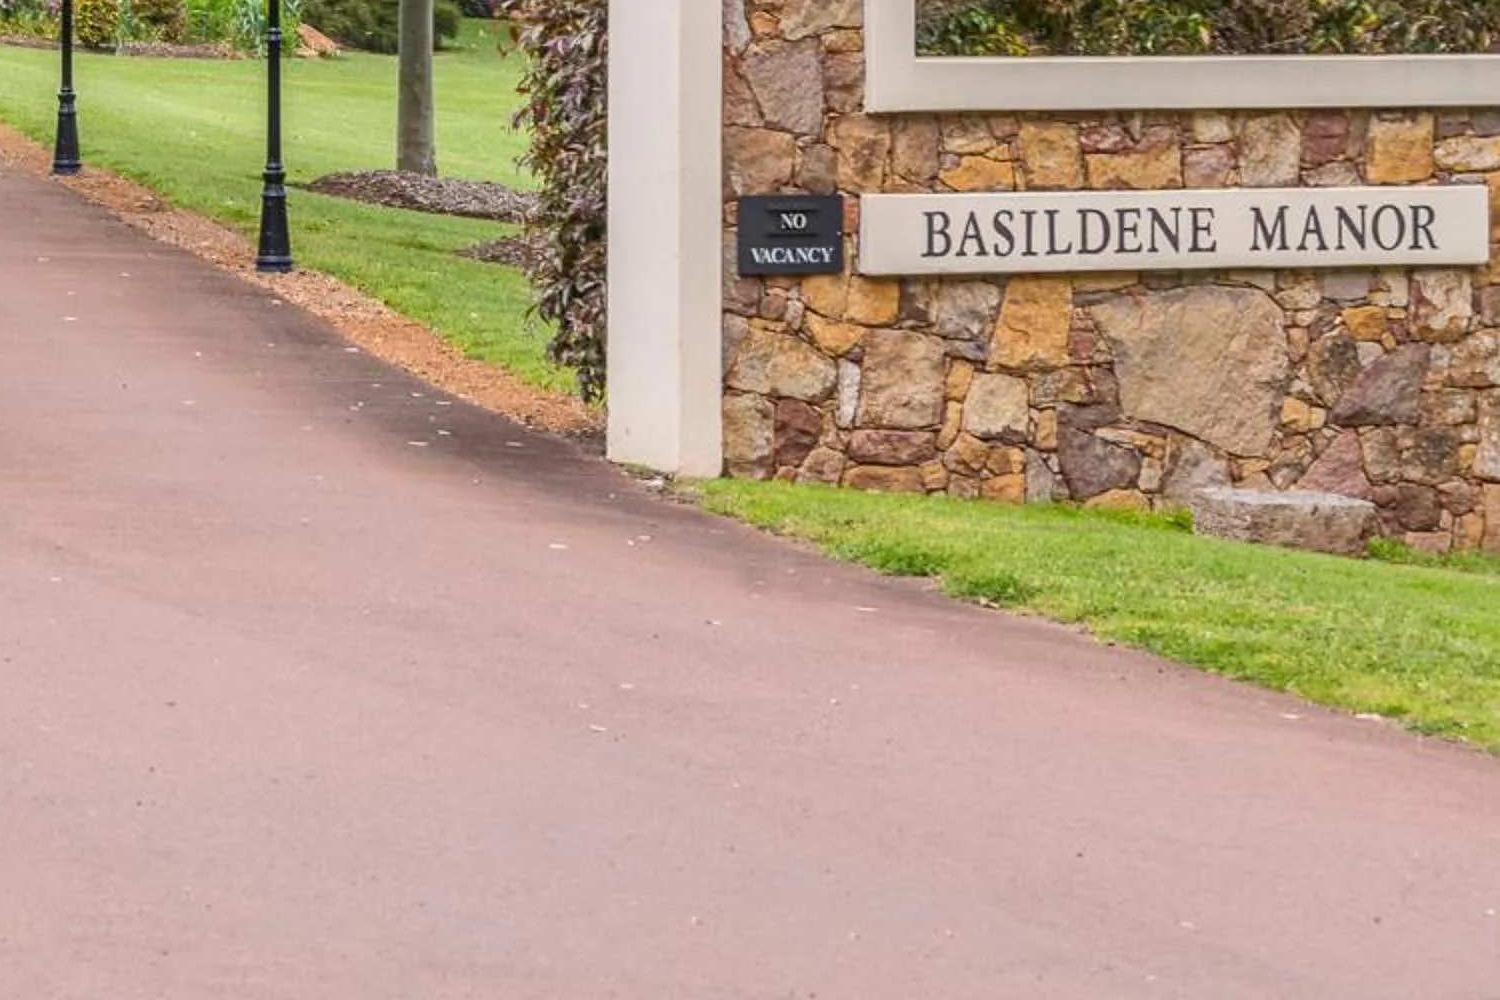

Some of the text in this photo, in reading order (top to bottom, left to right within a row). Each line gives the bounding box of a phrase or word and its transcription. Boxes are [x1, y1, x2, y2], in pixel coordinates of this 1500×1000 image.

[780, 212, 807, 230] NO
[920, 203, 1440, 258] BASILDENE MANOR
[749, 246, 834, 264] VACANCY
